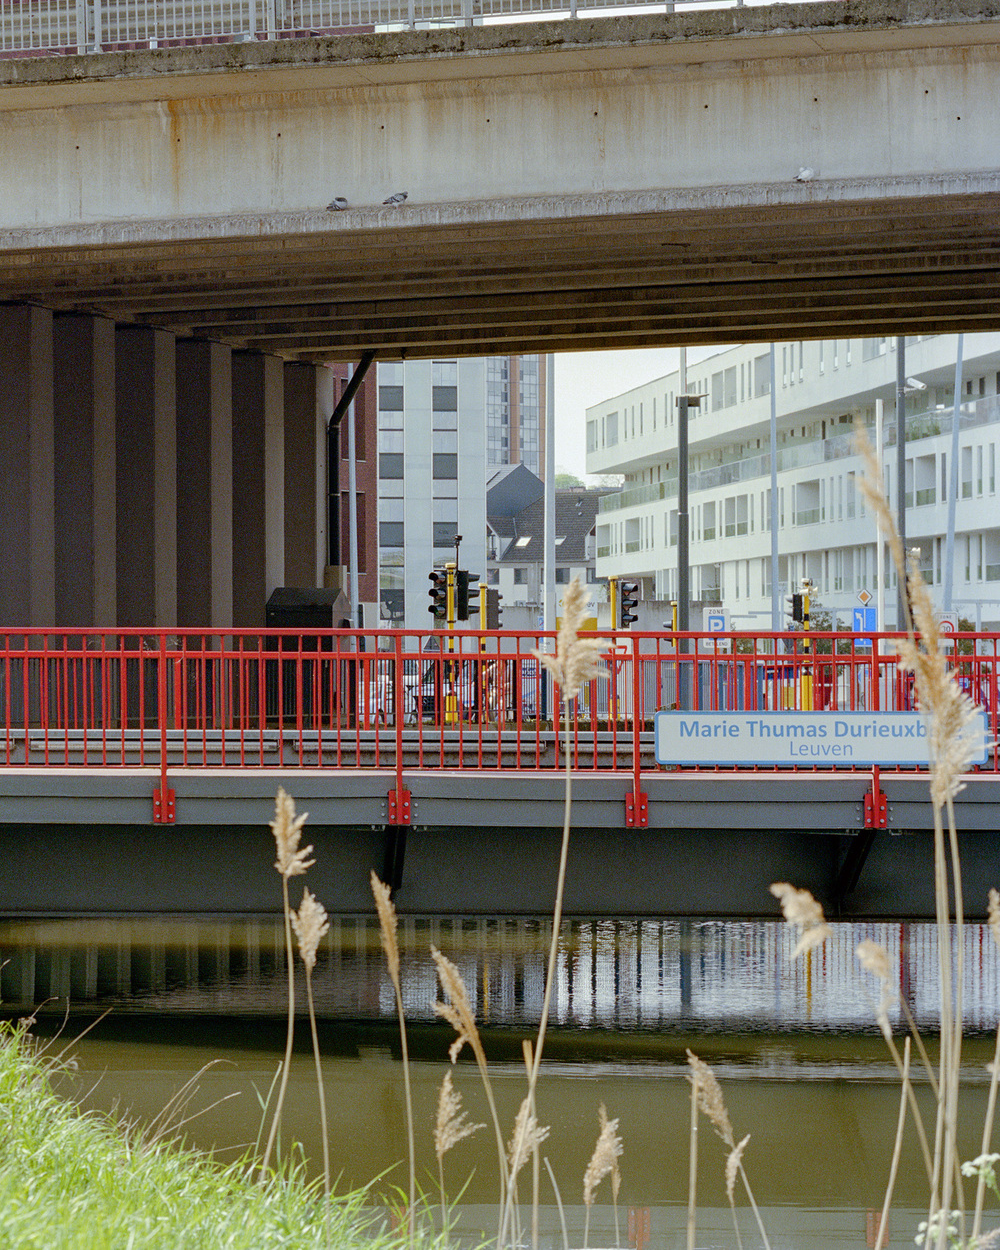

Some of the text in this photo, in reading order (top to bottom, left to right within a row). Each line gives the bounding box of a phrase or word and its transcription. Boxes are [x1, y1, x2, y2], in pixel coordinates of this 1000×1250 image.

[679, 720, 962, 741] Marie Thumas Durieuxb
[789, 741, 853, 756] Leuven
